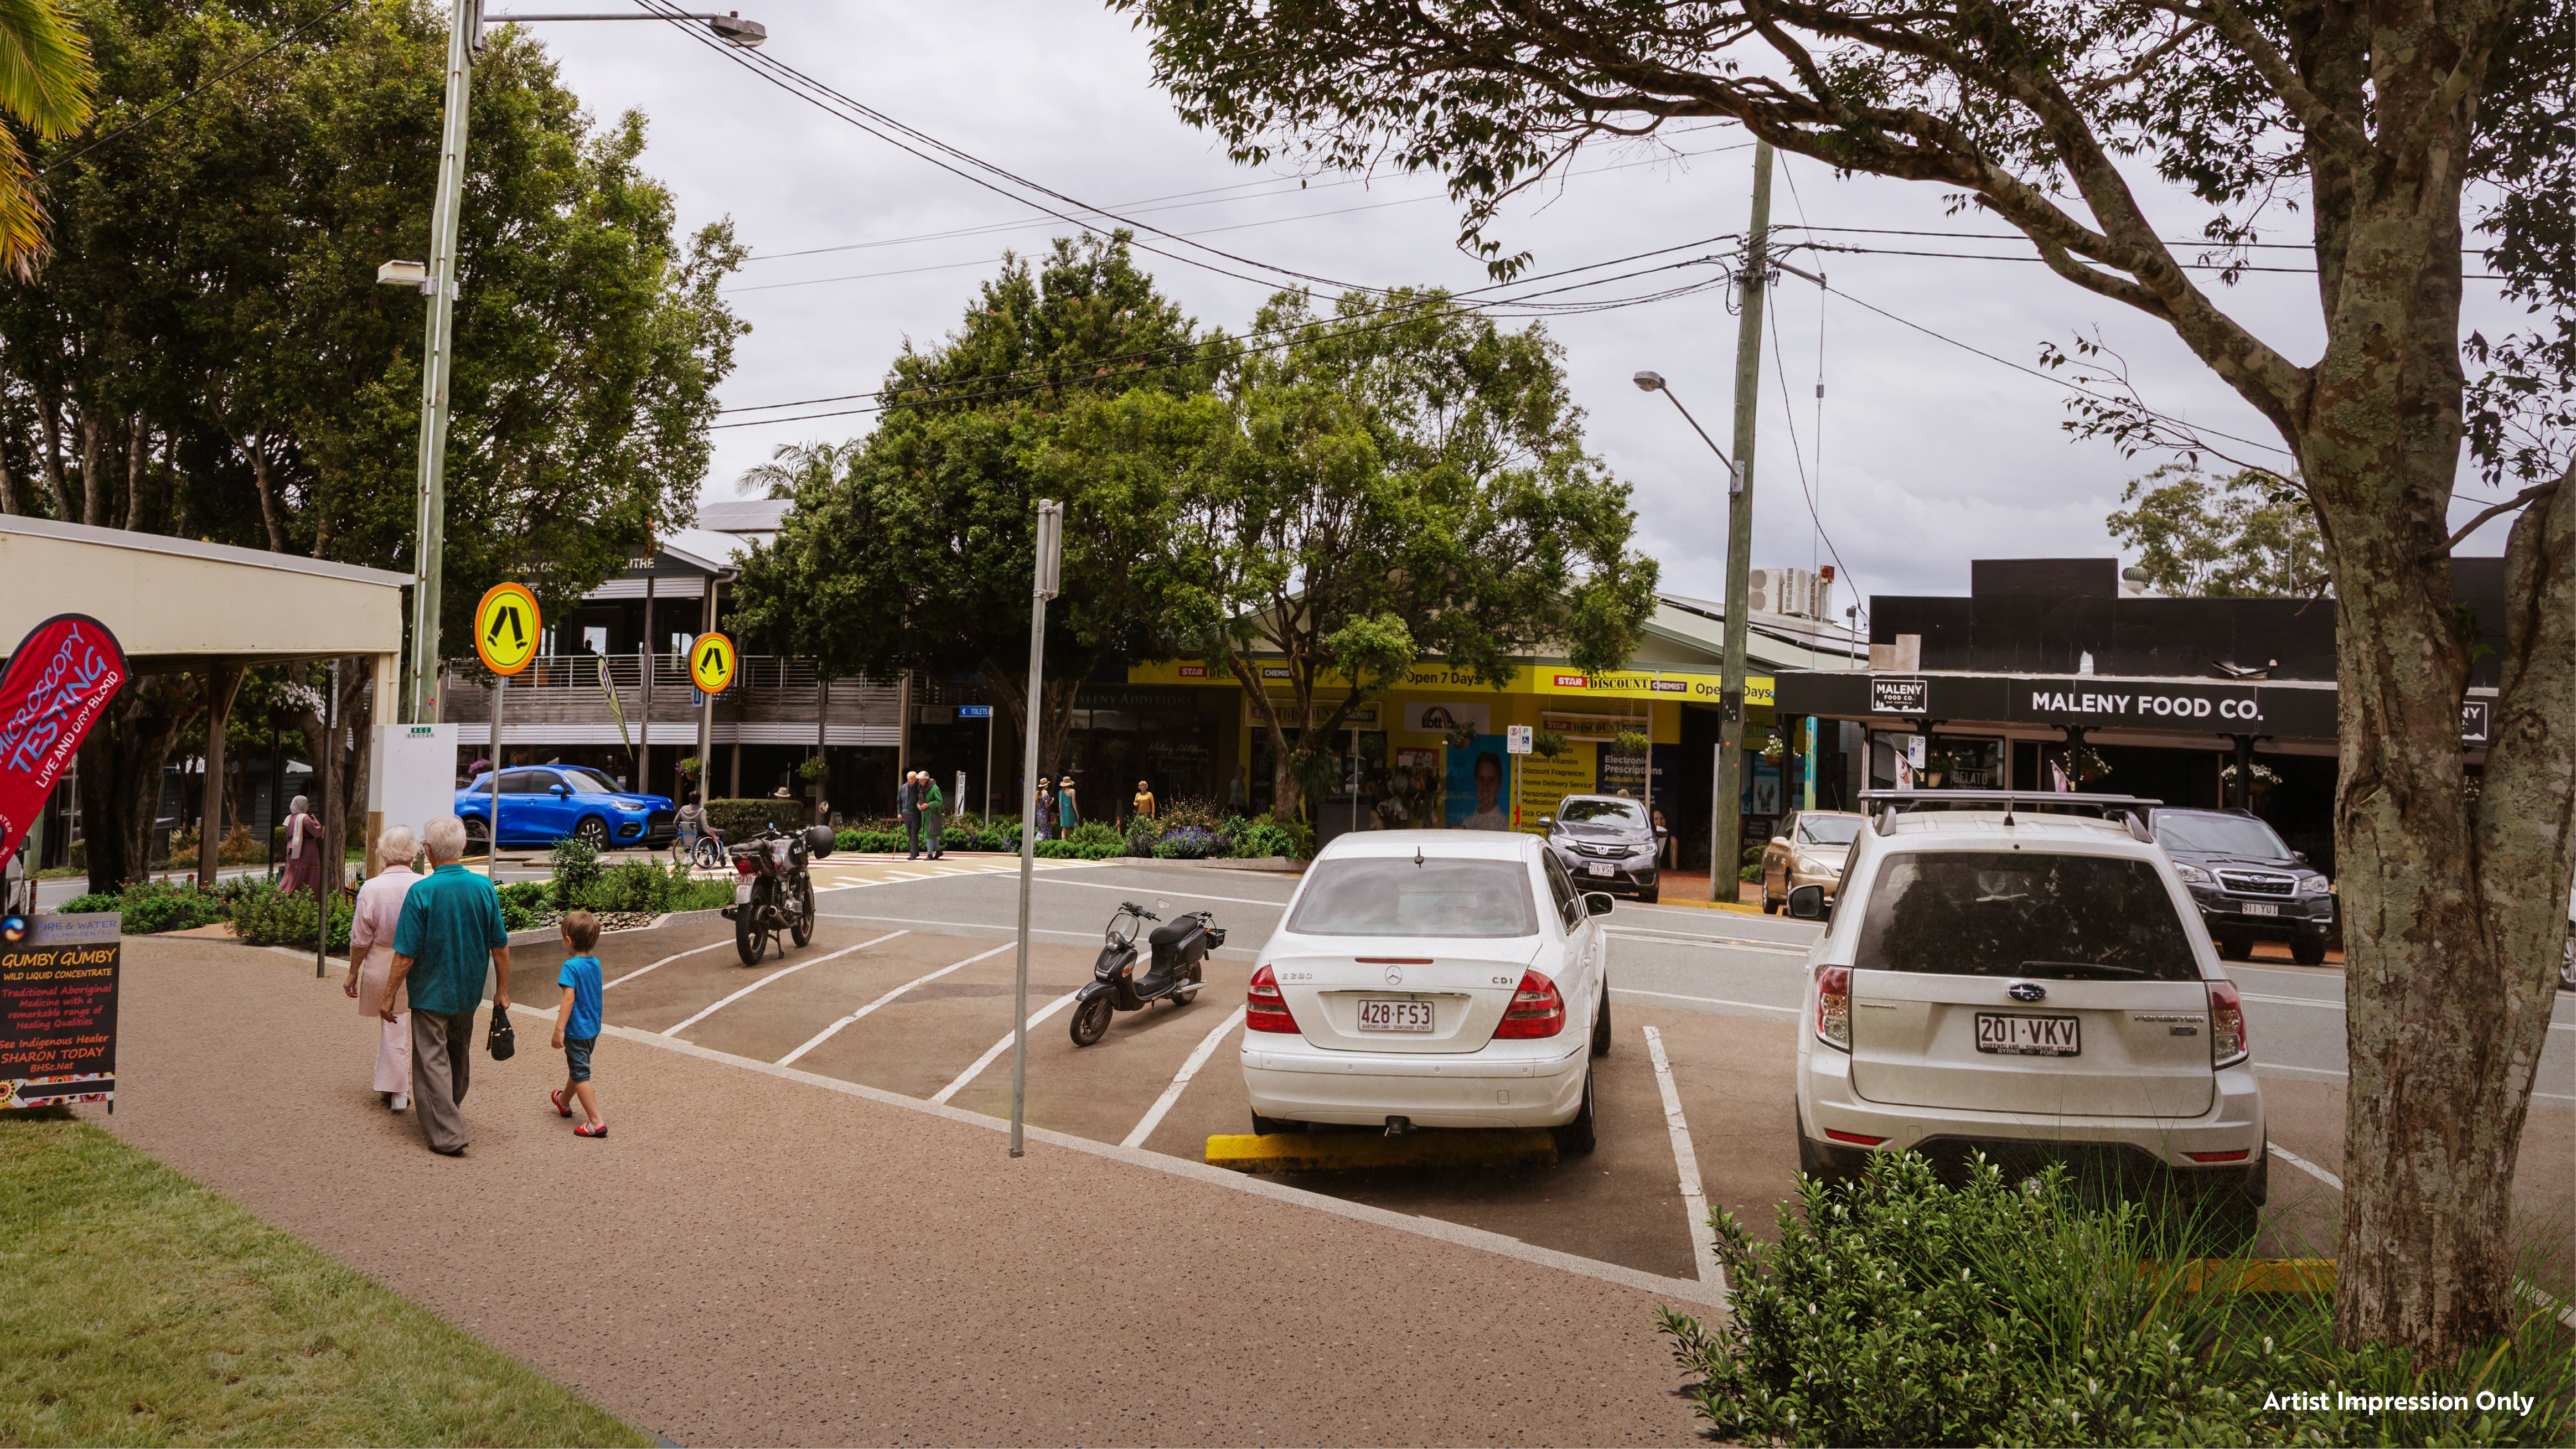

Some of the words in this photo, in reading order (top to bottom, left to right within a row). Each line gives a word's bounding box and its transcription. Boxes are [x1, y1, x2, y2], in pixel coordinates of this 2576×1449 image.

[1406, 672, 1437, 685] Open
[1441, 672, 1448, 683] 7
[1451, 672, 1481, 686] Days
[1558, 676, 1582, 686] STAR
[1590, 678, 1648, 689] DISCOUNT
[1652, 682, 1685, 691] CHEMIST
[1695, 682, 1721, 696] Ope
[1876, 684, 1922, 695] MALENY
[8, 645, 107, 772] TESTING
[2032, 692, 2130, 713] MALENY
[2138, 696, 2211, 717] FOOD
[2219, 699, 2264, 721] CO.
[35, 758, 59, 788] LIVE
[54, 732, 75, 762] AND
[71, 706, 90, 733] DRY
[87, 670, 118, 710] BLOOD
[1548, 721, 1567, 729] STAR
[1605, 764, 1663, 775] Prescriptins
[1953, 771, 1988, 785] GELATO
[1744, 837, 1767, 846] DOCTORS
[37, 923, 63, 932] FIRE
[66, 922, 74, 930] &
[77, 920, 117, 930] WATER
[2, 951, 59, 969] GUMBY
[60, 948, 117, 966] GUMBY
[3, 972, 24, 981] WILD
[26, 971, 53, 981] LIQUID
[55, 968, 112, 979] CONCENTRATE
[1, 986, 58, 998] Traditional
[60, 983, 112, 996] Aboriginal
[19, 999, 60, 1007] Medicine
[63, 997, 83, 1005] with
[8, 1008, 60, 1019] remarkable
[64, 1008, 90, 1017] range
[93, 1005, 104, 1014] of
[16, 1020, 51, 1030] Healing
[54, 1017, 93, 1028] Qualities
[0, 1041, 15, 1049] See
[19, 1037, 73, 1049] Indigenous
[76, 1033, 110, 1044] Healer
[1, 1050, 56, 1064] SHARON
[60, 1047, 105, 1059] TODAY
[30, 1062, 74, 1073] BHSc.Nat
